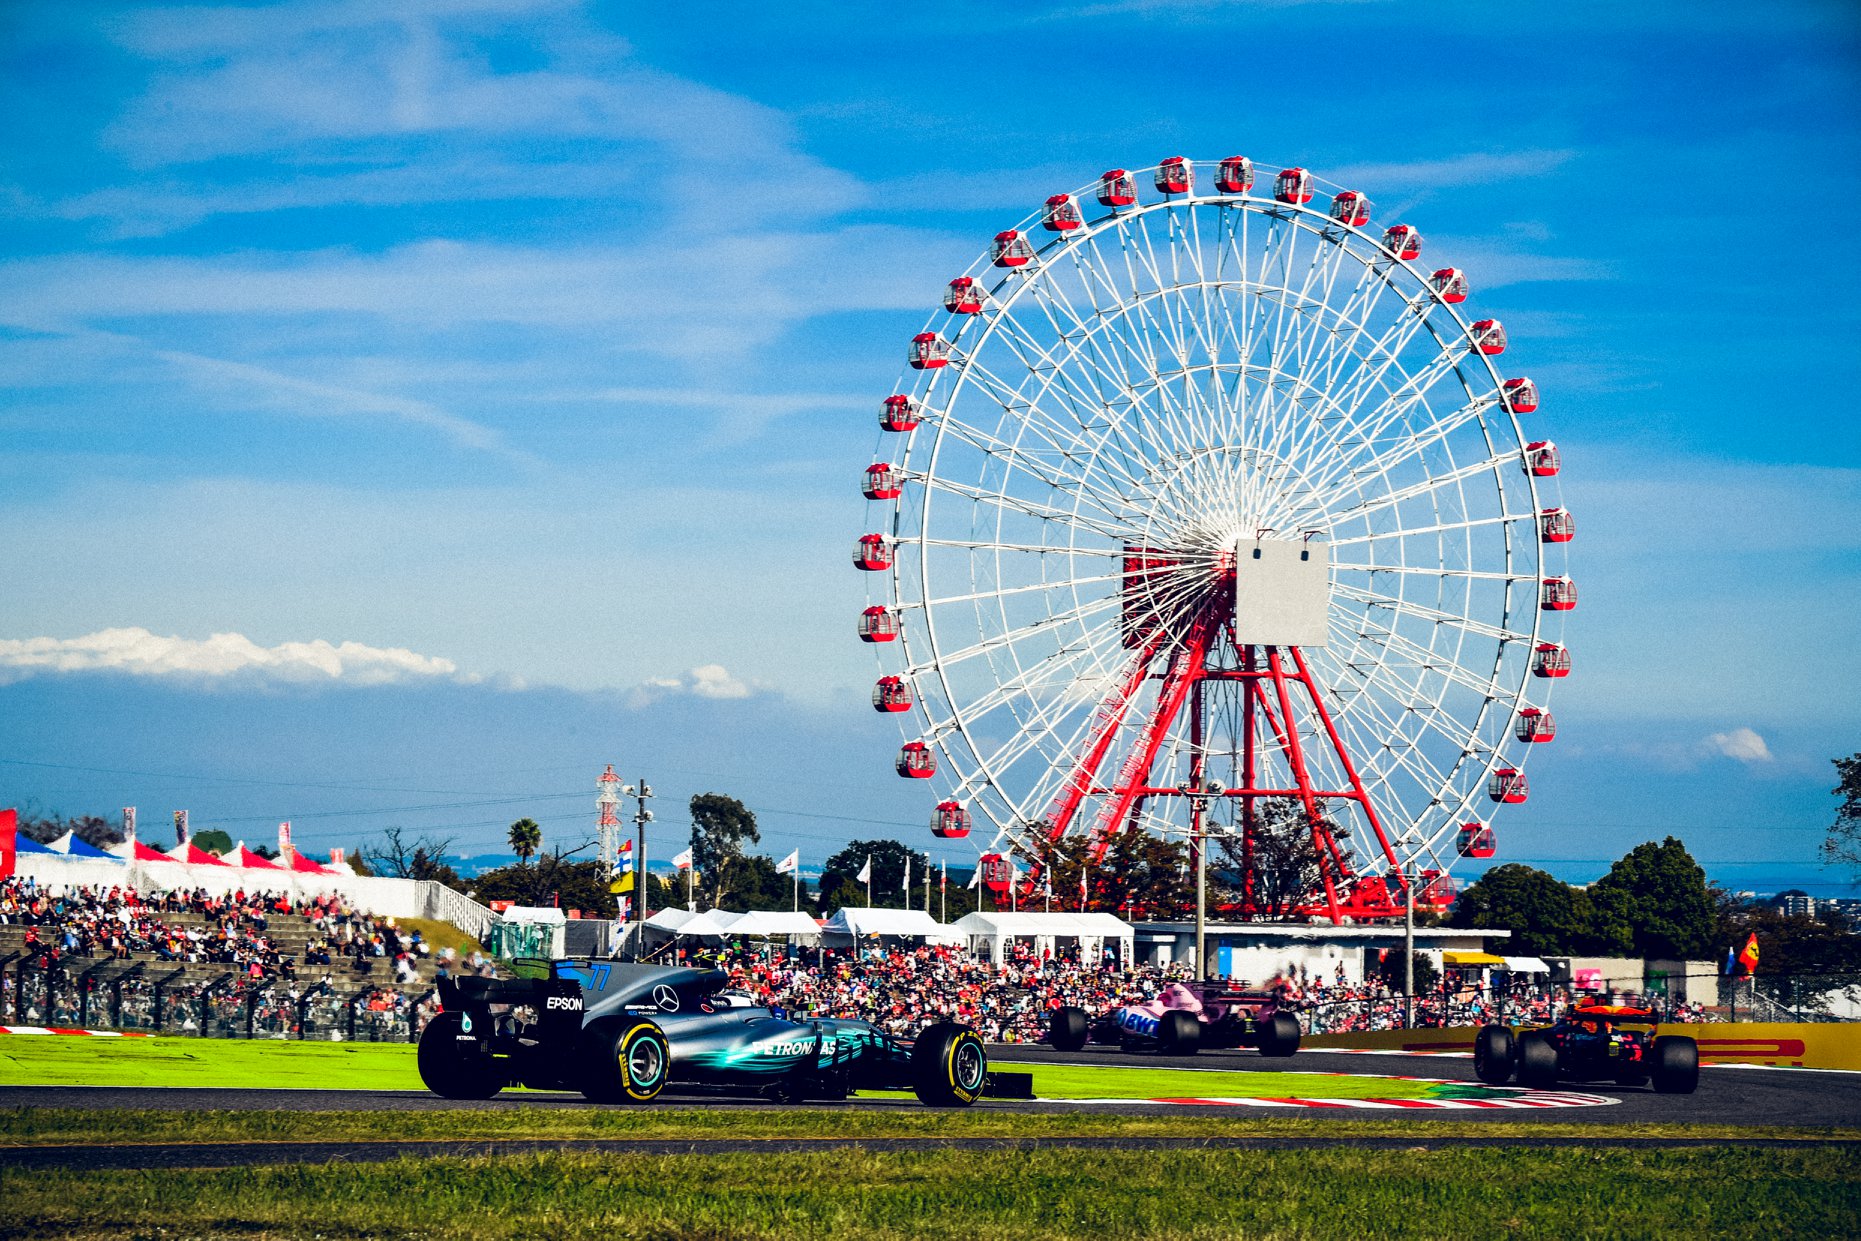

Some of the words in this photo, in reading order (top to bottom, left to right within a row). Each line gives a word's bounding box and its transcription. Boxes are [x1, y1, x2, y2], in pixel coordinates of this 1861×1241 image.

[587, 964, 611, 991] 77
[547, 997, 583, 1010] EPSON
[1126, 1013, 1160, 1037] BWT
